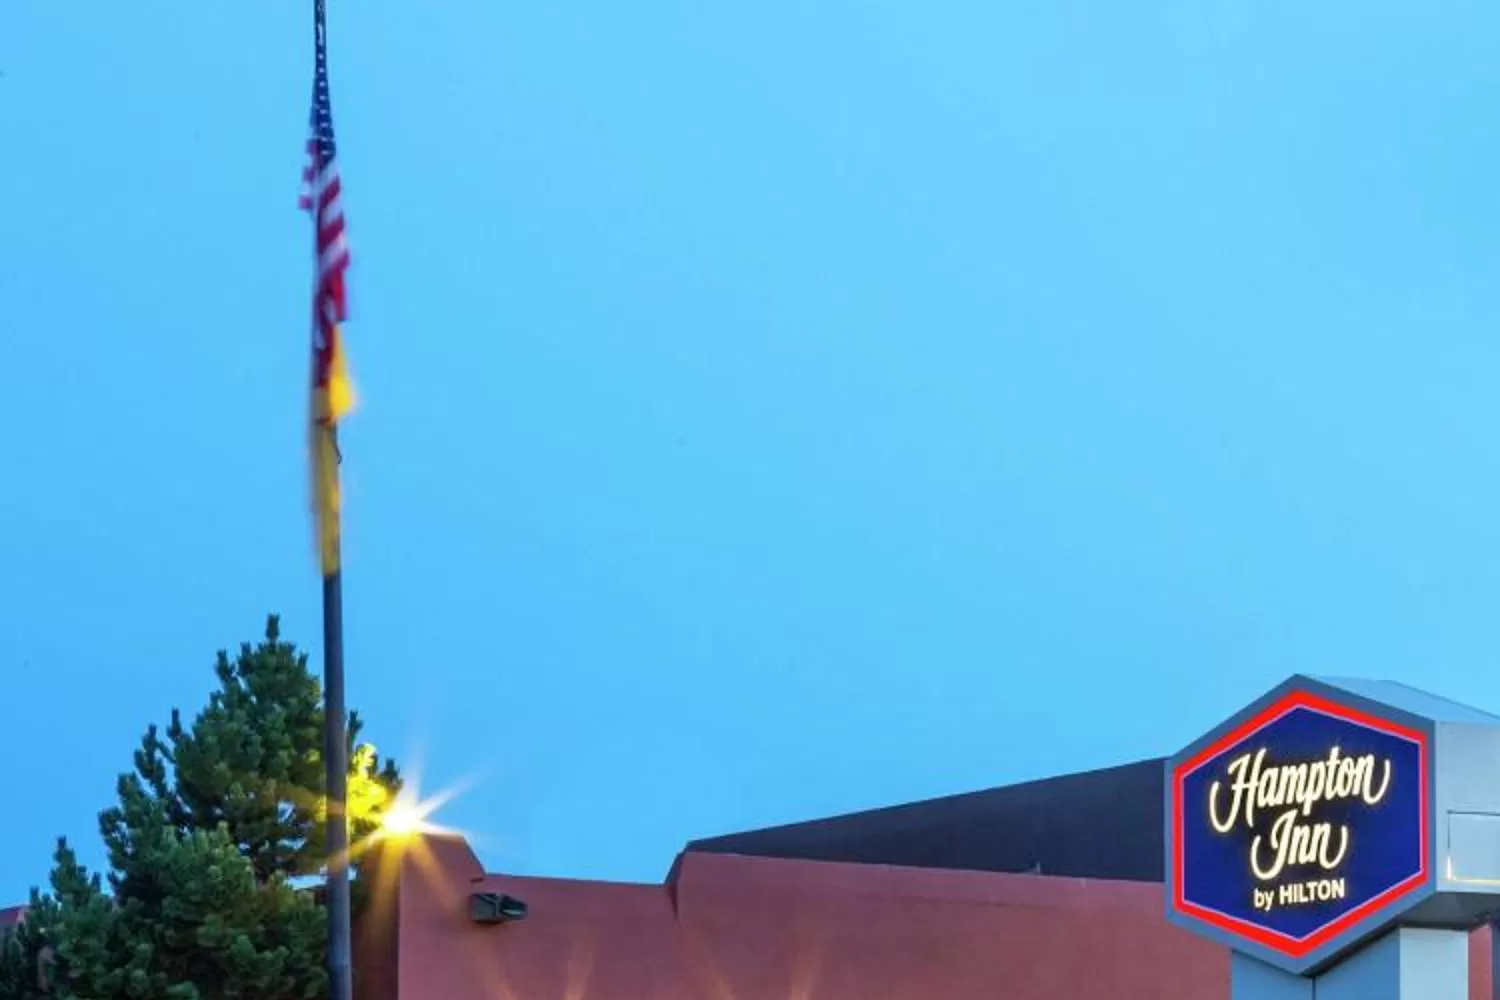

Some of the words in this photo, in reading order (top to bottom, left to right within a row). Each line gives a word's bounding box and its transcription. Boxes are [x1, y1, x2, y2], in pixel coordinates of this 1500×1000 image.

[1209, 746, 1391, 833] Hampton
[1251, 808, 1348, 880] Inn
[1253, 887, 1274, 912] by
[1279, 877, 1345, 905] HILTON
